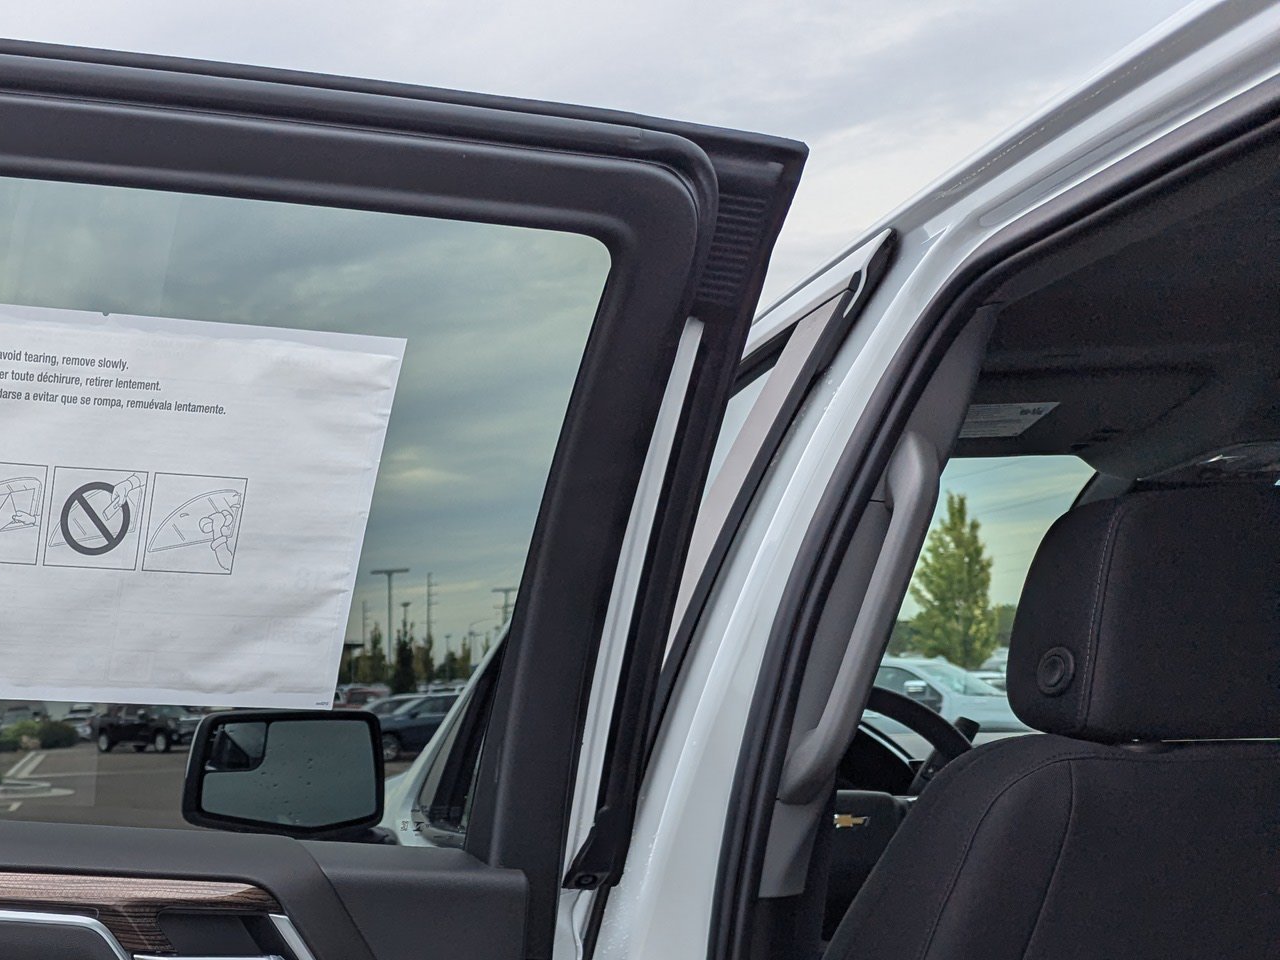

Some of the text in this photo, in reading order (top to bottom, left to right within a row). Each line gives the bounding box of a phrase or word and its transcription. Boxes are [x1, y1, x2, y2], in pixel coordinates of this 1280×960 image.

[24, 352, 59, 367] tearing,
[61, 356, 96, 368] remove
[97, 357, 129, 372] slowly.
[11, 370, 35, 382] toute
[37, 372, 83, 387] déchirure,
[85, 376, 114, 388] retirer
[115, 378, 162, 391] lentement.
[24, 391, 30, 401] a
[32, 391, 59, 403] evitar
[60, 394, 78, 406] que
[80, 397, 91, 406] se
[93, 397, 124, 409] rompa,
[126, 398, 172, 411] remuévala
[174, 401, 227, 415] lentamente.
